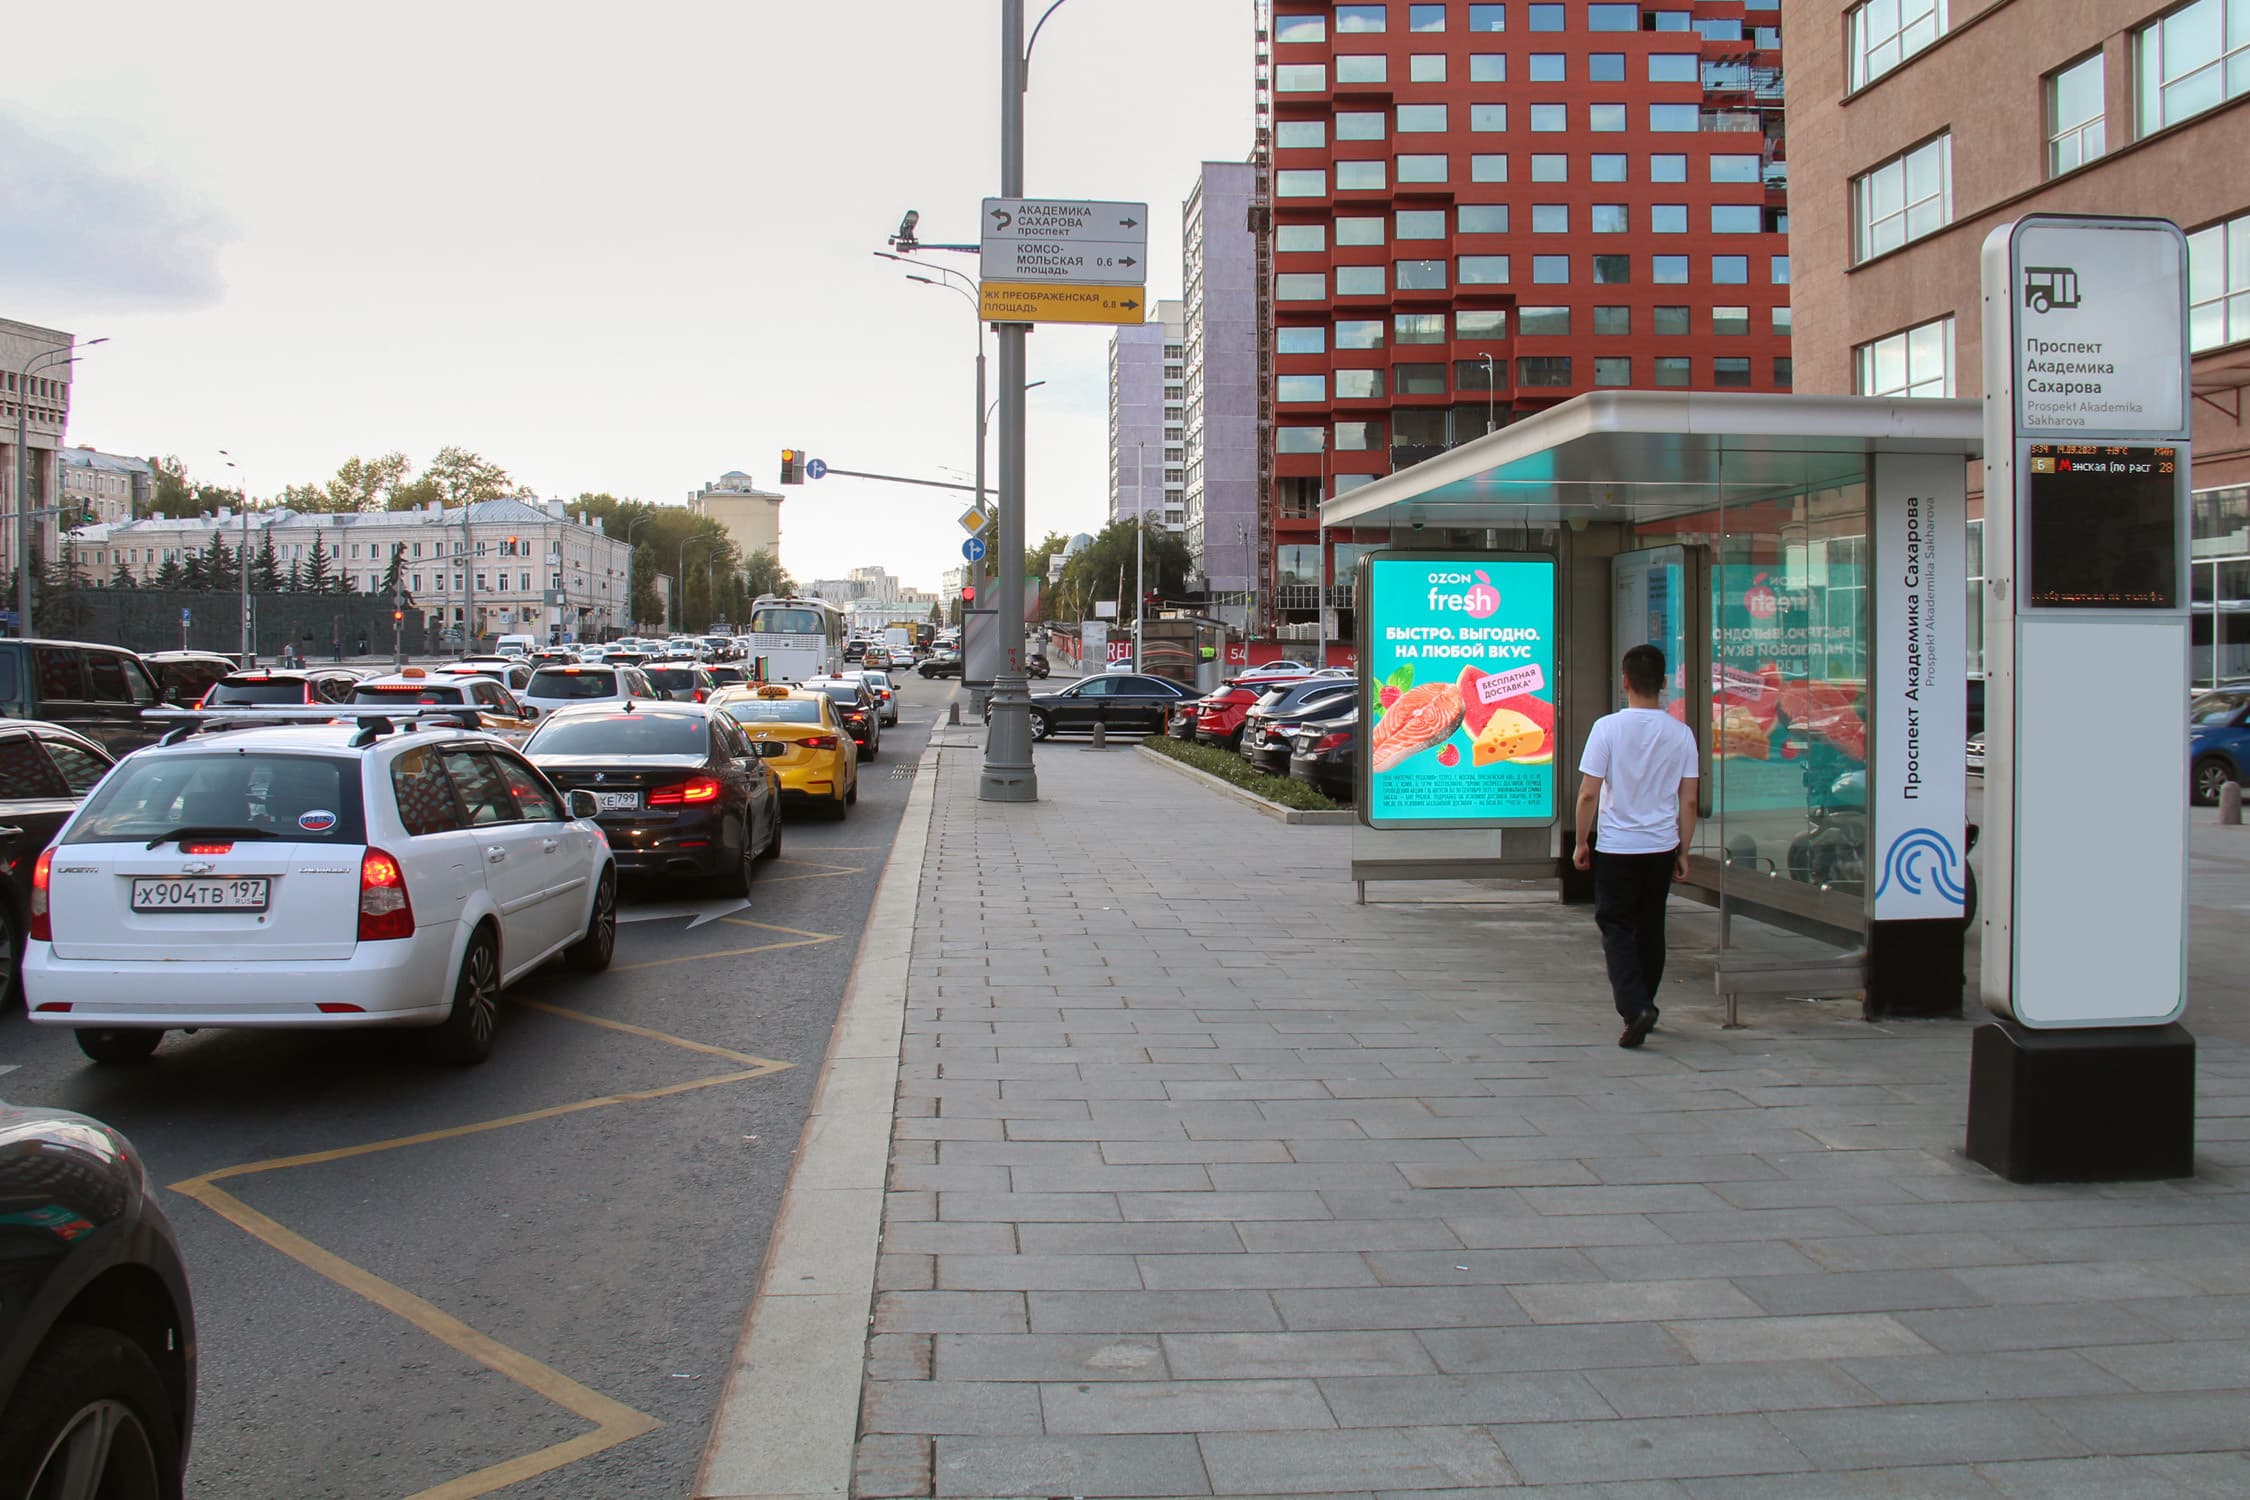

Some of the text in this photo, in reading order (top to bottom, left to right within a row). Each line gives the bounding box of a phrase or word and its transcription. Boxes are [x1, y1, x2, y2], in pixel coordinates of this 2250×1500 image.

[1018, 205, 1092, 217] АКАДЕМИКА
[1018, 216, 1083, 227] САХАРОВА
[1017, 227, 1071, 237] проспект
[1017, 244, 1064, 254] КОМСО-
[1016, 255, 1084, 267] МОЛЬСКАЯ
[1096, 257, 1113, 267] 0.6
[1016, 265, 1069, 276] площадь
[984, 290, 1100, 302] ЖК ПРЕОБРАЖЕНСКАЯ
[984, 303, 1038, 313] ПЛОЩАДЬ
[2026, 338, 2103, 355] Проспект
[2026, 358, 2115, 375] Академика
[2027, 378, 2103, 396] Сахарова
[2027, 400, 2143, 413] Prospekt Akademika
[2027, 414, 2086, 426] Sakharova
[2159, 462, 2174, 473] 28
[1427, 573, 1471, 584] OZON
[1925, 497, 1936, 687] Prospekt Akademika Sakharova
[1427, 587, 1492, 611] fresh
[1385, 627, 1541, 642] БЫСТРО. ВЫГОДНО.
[1395, 642, 1531, 658] НА ЛЮБОЙ ВКУС
[1904, 497, 1921, 799] Проспект Академика Сахарова
[1482, 669, 1536, 690] БЕСПЛАТНАЯ
[617, 793, 635, 803] 799
[230, 881, 261, 898] 197
